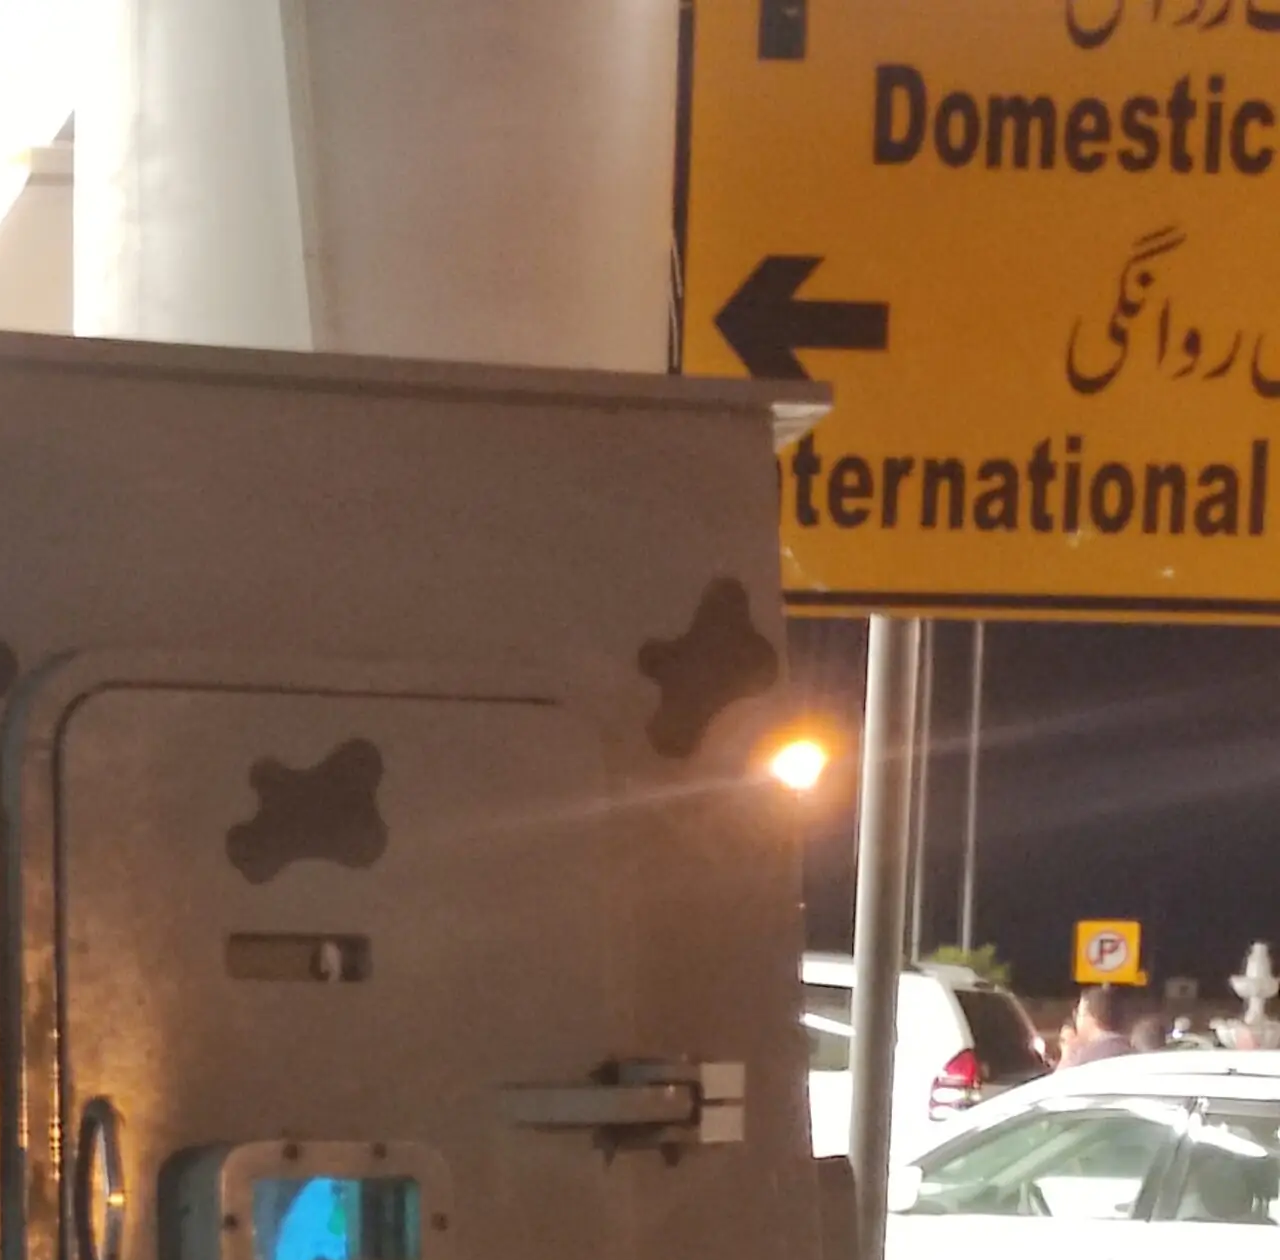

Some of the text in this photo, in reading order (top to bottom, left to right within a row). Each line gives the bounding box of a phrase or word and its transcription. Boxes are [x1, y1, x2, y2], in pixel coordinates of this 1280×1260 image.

[873, 63, 1275, 175] Domestic
[1067, 223, 1243, 395] روانگی
[777, 432, 1270, 537] ternational
